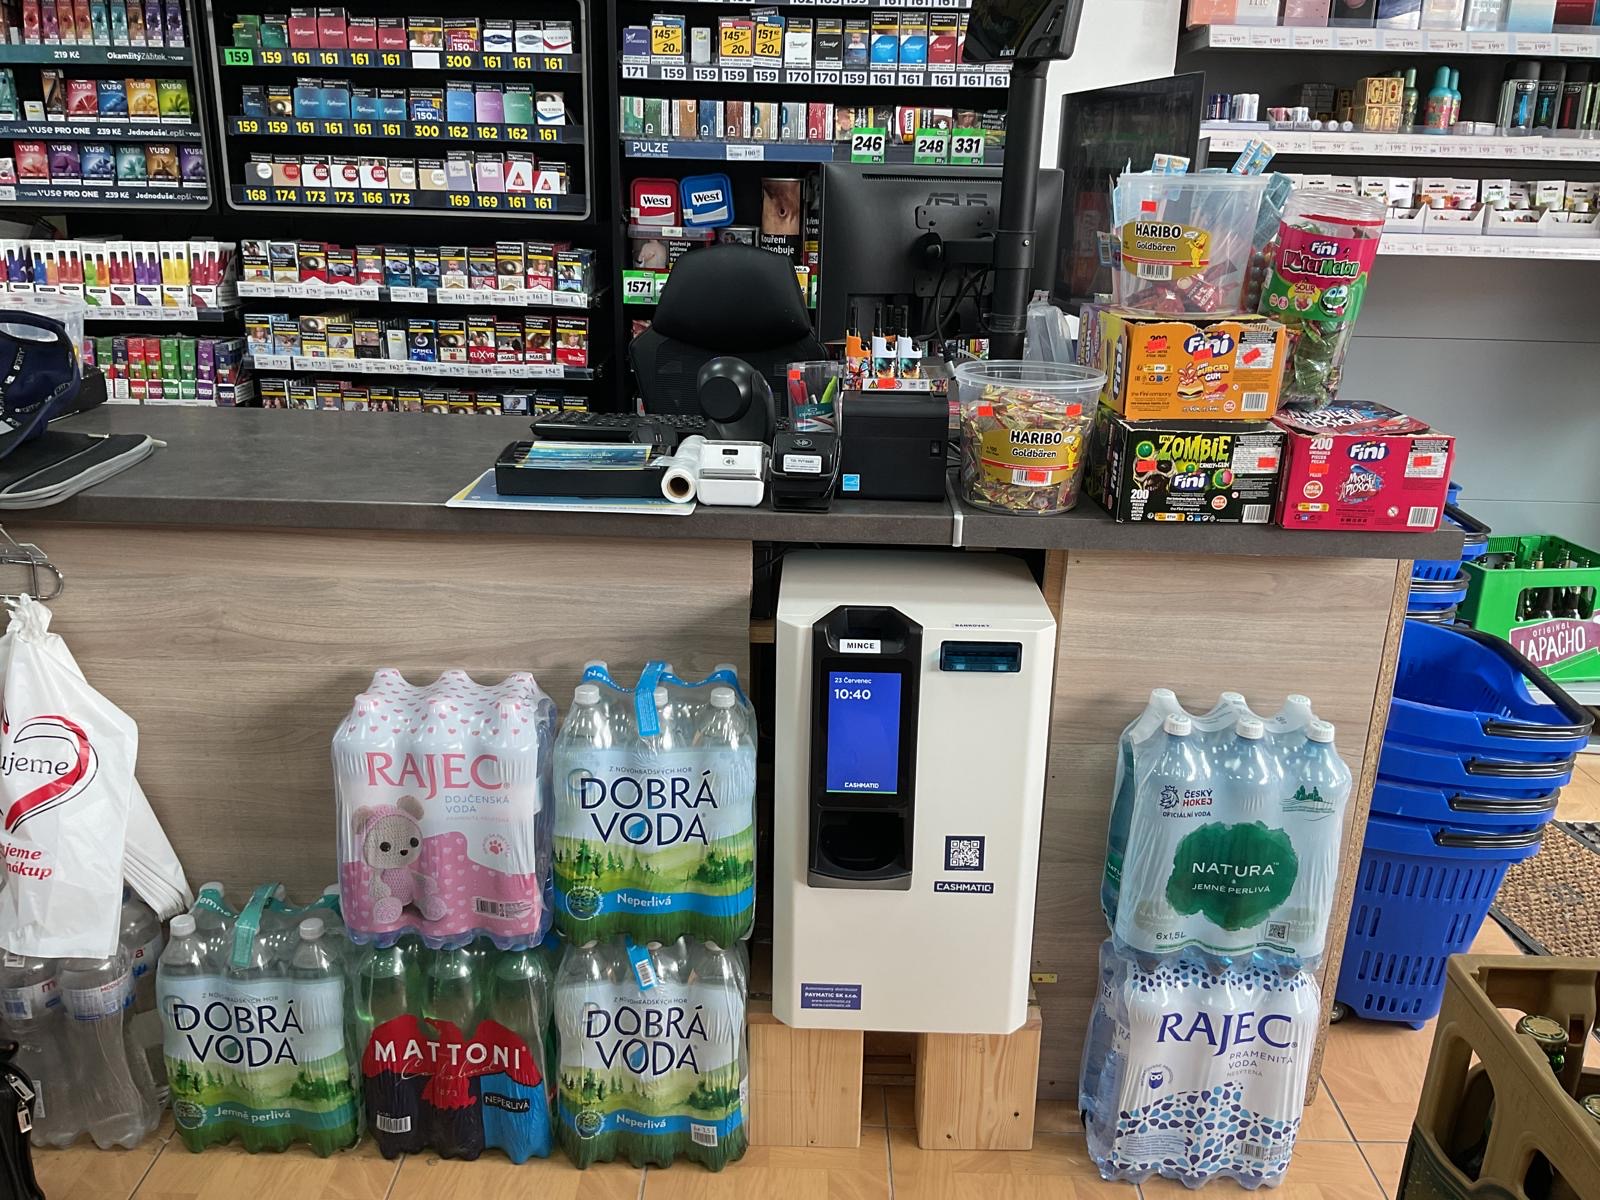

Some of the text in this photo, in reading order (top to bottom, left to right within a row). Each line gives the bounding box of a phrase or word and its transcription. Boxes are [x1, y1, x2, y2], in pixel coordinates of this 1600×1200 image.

[655, 29, 670, 38] 145
[724, 31, 739, 40] 145
[758, 29, 773, 39] 151
[663, 43, 675, 52] 20
[732, 45, 744, 54] 20
[761, 44, 774, 54] 20
[54, 51, 67, 59] 219
[228, 51, 249, 63] 159
[261, 52, 282, 64] 159
[292, 52, 310, 64] 161
[320, 52, 338, 64] 161
[351, 53, 369, 65] 161
[382, 53, 400, 65] 161
[446, 56, 471, 68] 300
[483, 56, 501, 68] 161
[513, 57, 531, 69] 161
[544, 57, 562, 70] 161
[626, 66, 644, 77] 171
[663, 67, 684, 78] 159
[696, 68, 716, 79] 159
[724, 69, 745, 80] 159
[756, 70, 776, 81] 159
[789, 71, 810, 82] 170
[817, 72, 837, 83] 170
[844, 73, 865, 84] 159
[874, 73, 892, 84] 161
[903, 74, 920, 84] 161
[935, 75, 953, 85] 161
[963, 75, 981, 86] 161
[989, 75, 1008, 86] 161
[97, 128, 110, 136] 239
[237, 120, 258, 132] 159
[268, 121, 288, 133] 159
[296, 121, 314, 133] 161
[325, 122, 343, 134] 161
[353, 123, 371, 135] 161
[382, 123, 400, 135] 161
[414, 125, 439, 137] 300
[448, 126, 468, 138] 162
[477, 126, 498, 138] 162
[507, 128, 528, 140] 162
[539, 128, 557, 140] 161
[633, 142, 669, 153] PULZE
[854, 136, 882, 151] 246
[919, 140, 943, 153] 248
[955, 139, 981, 153] 331
[105, 191, 119, 199] 239
[246, 190, 266, 201] 168
[275, 190, 296, 201] 174
[306, 190, 326, 202] 173
[334, 191, 354, 202] 173
[362, 192, 382, 203] 166
[390, 193, 410, 204] 173
[449, 195, 470, 206] 169
[643, 196, 669, 206] West
[694, 192, 720, 203] West
[478, 196, 498, 207] 169
[508, 196, 526, 208] 161
[534, 197, 551, 209] 161
[1135, 224, 1181, 239] HARIBO
[1136, 241, 1176, 252] Goldbären
[1311, 242, 1338, 256] Fini
[627, 280, 652, 293] 1571
[1188, 334, 1230, 354] Fini
[1205, 373, 1221, 381] GUM
[1010, 431, 1062, 445] HARIBO
[1309, 438, 1333, 450] 200
[1012, 448, 1057, 458] Goldbären
[1350, 442, 1386, 460] Fini
[1174, 472, 1206, 489] Fini
[1130, 489, 1149, 500] 200
[846, 642, 875, 650] MINCE
[1520, 626, 1585, 662] LAPACHO
[843, 676, 872, 685] Červenec
[834, 688, 871, 700] 10:40
[365, 752, 503, 800] RAJEC
[580, 770, 718, 810] DOBRÁ
[1184, 788, 1212, 799] ČESKÝ
[445, 793, 510, 804] DOJČENSKÁ
[1183, 798, 1213, 807] HOKEJ
[446, 805, 477, 813] VODA
[1163, 810, 1193, 818] OFICIÁLNÍ
[591, 812, 709, 846] VODA
[1192, 863, 1275, 878] NATURA
[936, 883, 992, 893] CASHMATIC
[1228, 885, 1271, 894] PERLIVÁ
[617, 893, 672, 906] Neperlivá
[173, 1000, 304, 1034] DOBRÁ
[586, 1005, 708, 1041] DOBRÁ
[1157, 1011, 1292, 1057] RAJEC
[187, 1034, 298, 1067] VODA
[375, 1039, 520, 1069] MATTONI
[595, 1038, 700, 1076] VODA
[1229, 1050, 1293, 1065] PRAMENITÁ
[1228, 1059, 1258, 1069] VODA
[485, 1096, 530, 1110] NEPERLIVÁ
[214, 1106, 291, 1123] Jemně perlivá
[616, 1114, 667, 1129] Neperlivá
